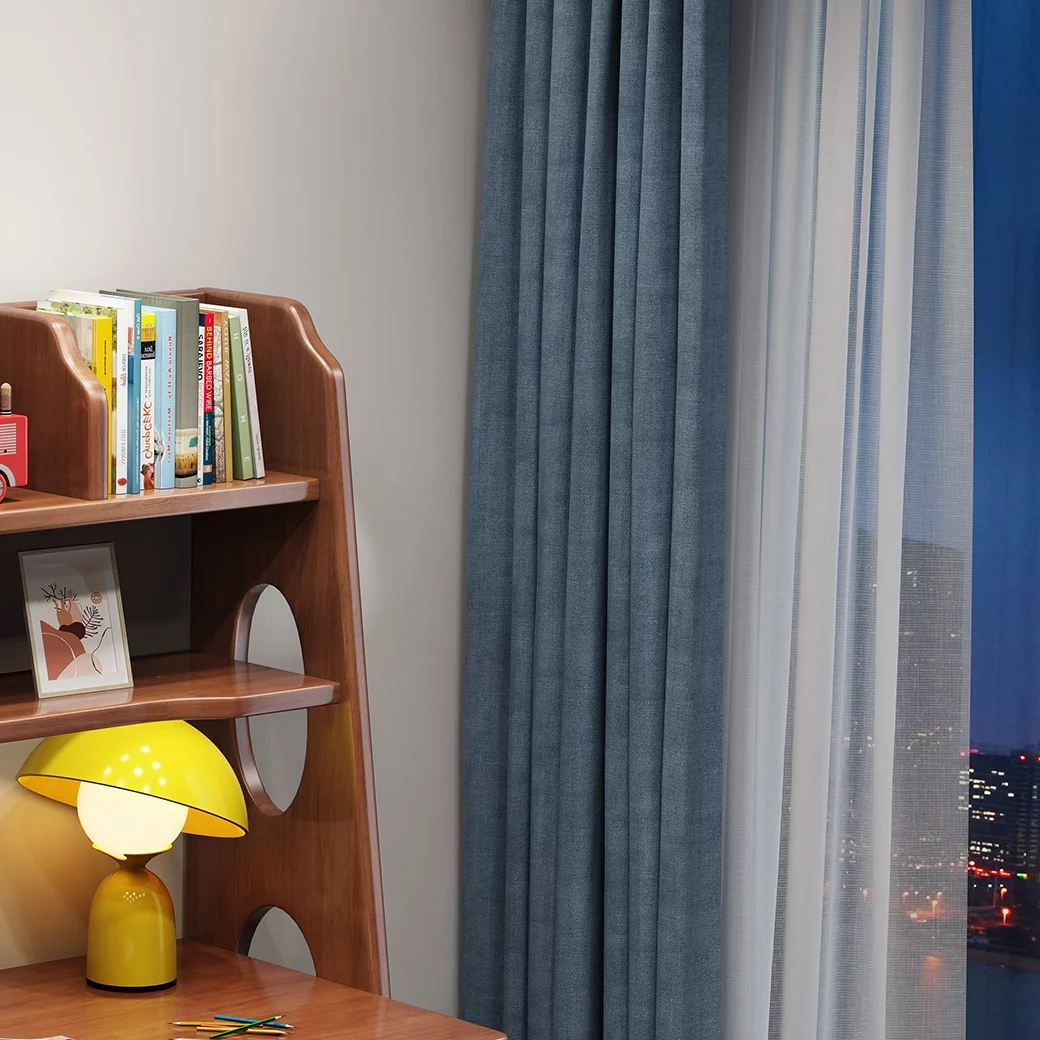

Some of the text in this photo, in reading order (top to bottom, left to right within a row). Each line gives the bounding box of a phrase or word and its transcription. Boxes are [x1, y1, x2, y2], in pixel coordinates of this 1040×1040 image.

[205, 326, 213, 410] BEHIND BARBED WIRE
